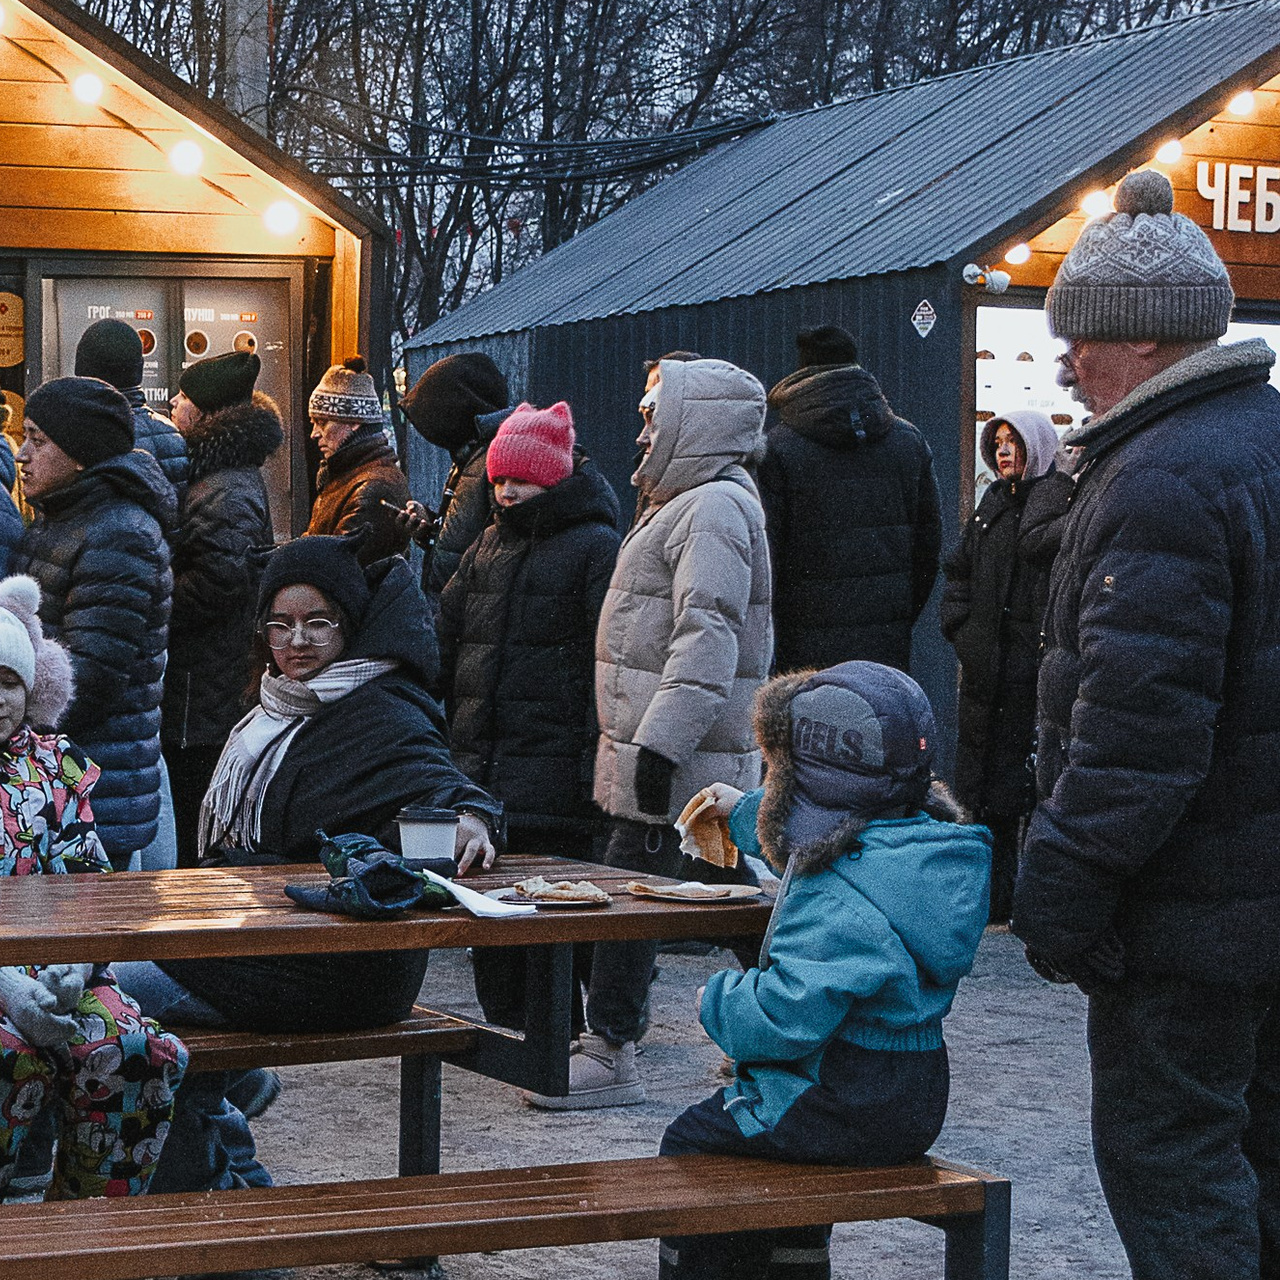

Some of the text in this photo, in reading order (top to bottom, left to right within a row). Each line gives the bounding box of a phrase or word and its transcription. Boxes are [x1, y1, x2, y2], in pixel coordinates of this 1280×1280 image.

[1196, 161, 1280, 233] ЧЕБ
[87, 305, 111, 320] ГРОГ
[184, 307, 215, 322] ПУНШ
